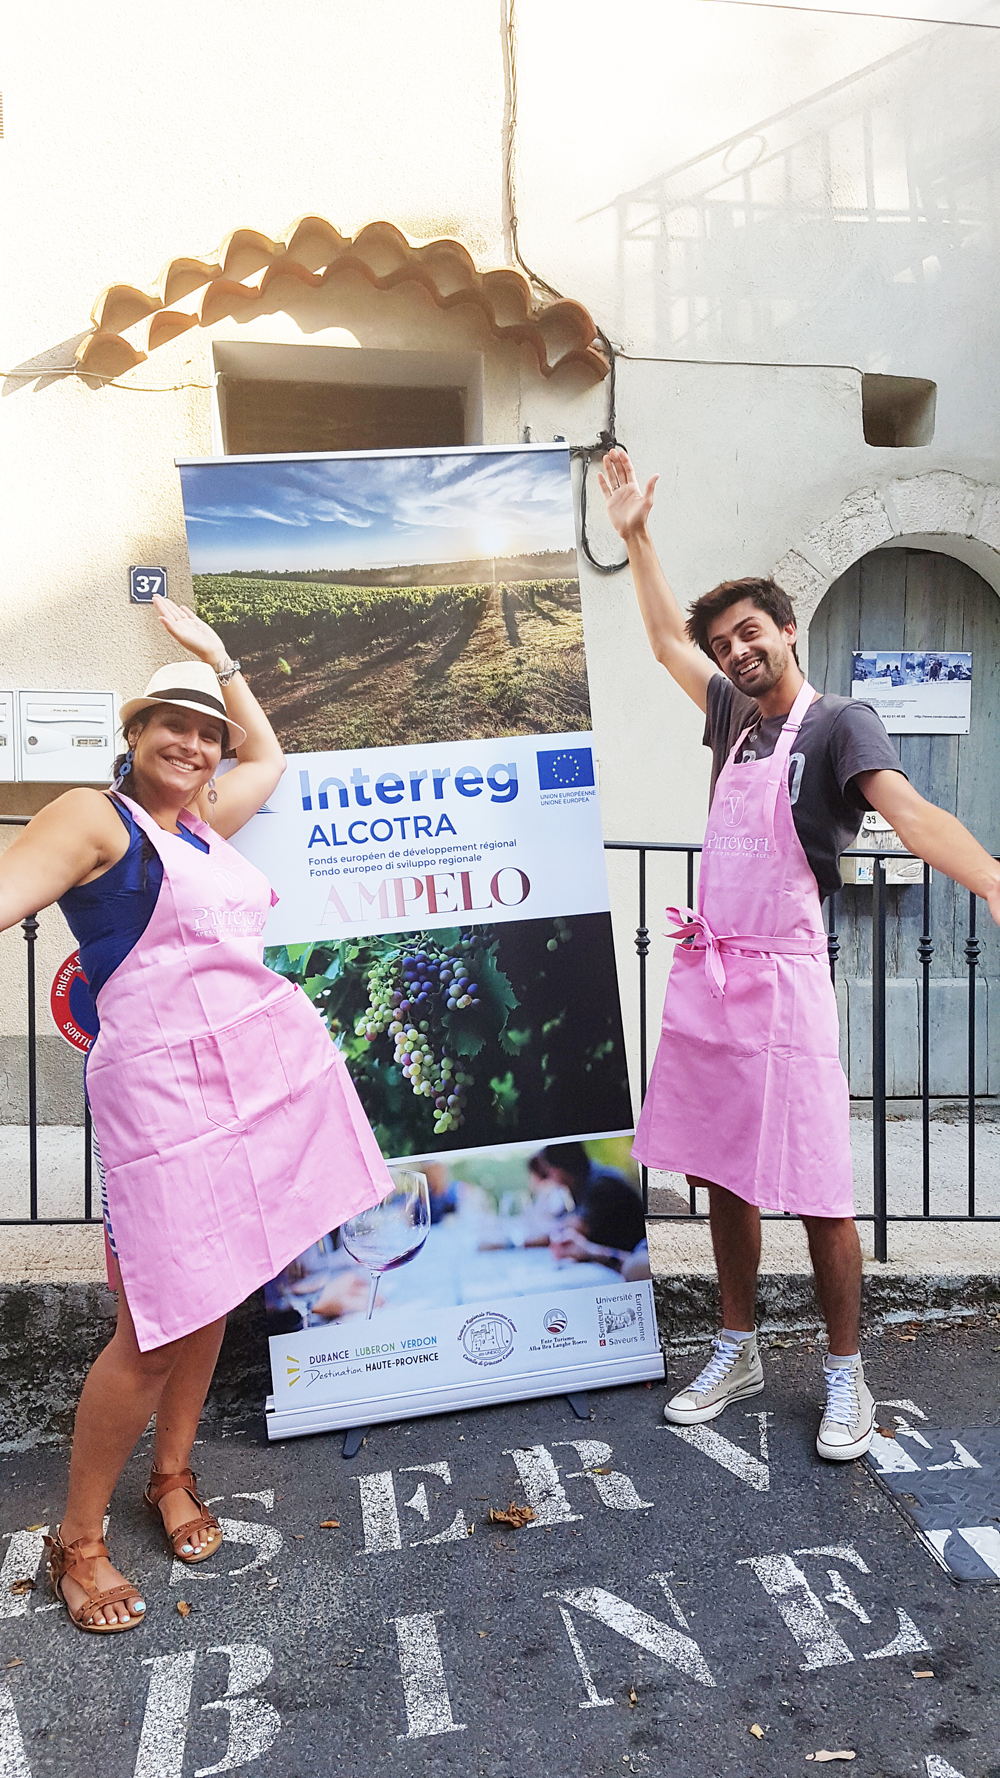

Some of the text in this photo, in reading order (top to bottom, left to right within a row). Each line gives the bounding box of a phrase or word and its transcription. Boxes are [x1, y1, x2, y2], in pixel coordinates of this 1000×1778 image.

[136, 576, 162, 593] 37
[299, 762, 519, 811] Interreg
[559, 790, 596, 798] EUROPÉENNE
[307, 813, 458, 848] ALCOTRA
[866, 816, 876, 824] 39
[308, 838, 517, 866] Fonds européen de développement régional
[310, 854, 482, 877] Fondo europeo di sviluppo regionale
[314, 867, 531, 926] AMPELO
[56, 962, 76, 997] PRIÈRE
[596, 1293, 633, 1304] Université
[596, 1304, 606, 1338] Senteurs
[608, 1336, 638, 1346] Saveurs
[635, 1293, 646, 1342] Européenne
[310, 1336, 437, 1364] DURANCE LUBERON VERDON
[304, 1352, 439, 1388] Destination HAUTE-PROVENCE
